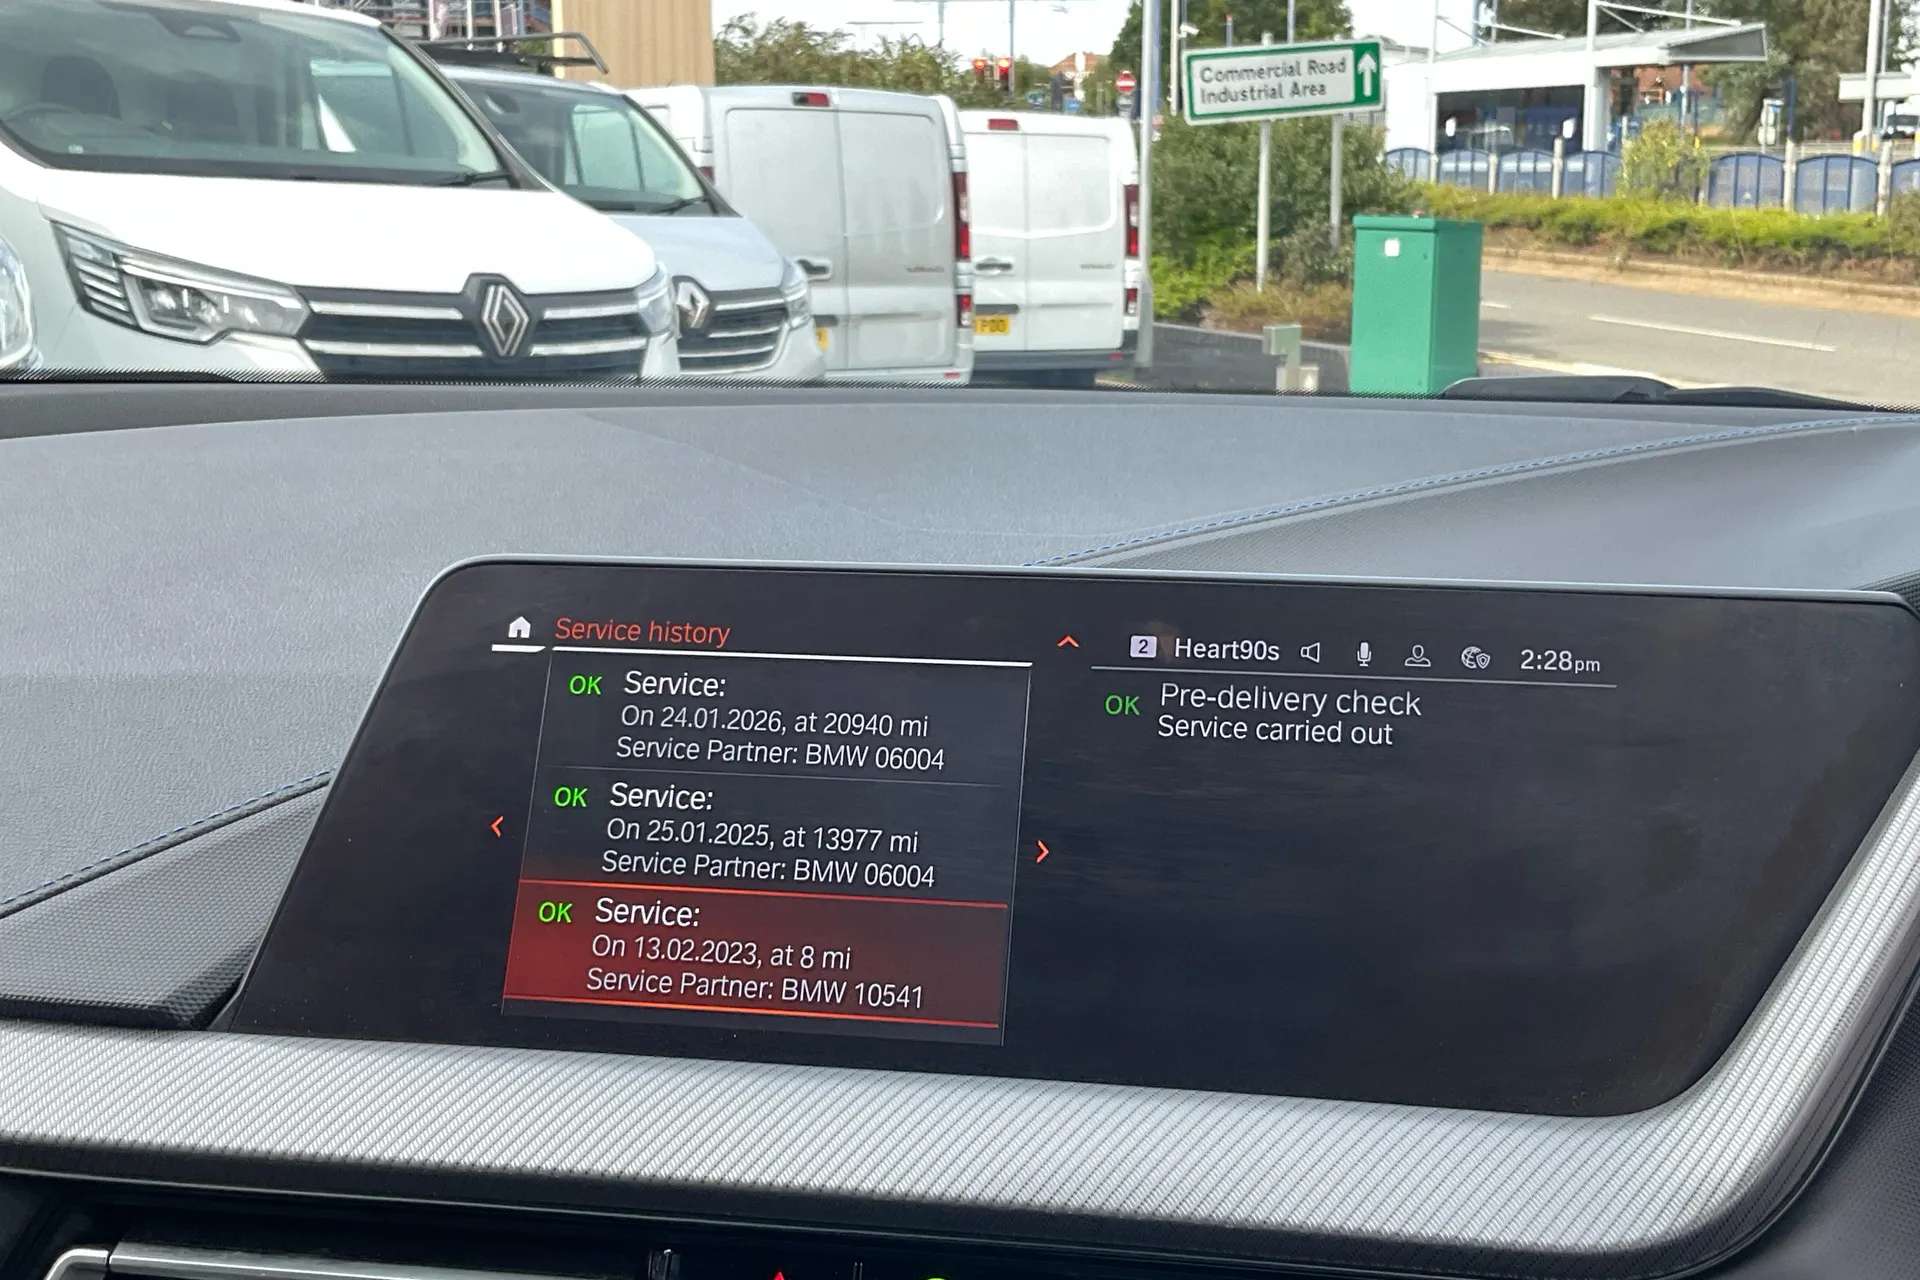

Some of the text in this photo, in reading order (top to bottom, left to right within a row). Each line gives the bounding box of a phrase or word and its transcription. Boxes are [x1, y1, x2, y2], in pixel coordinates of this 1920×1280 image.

[1200, 57, 1346, 84] Commercial Road
[1200, 80, 1327, 104] Industrial Area
[555, 617, 731, 649] Service history
[1138, 638, 1149, 655] 2
[1174, 637, 1280, 661] Heart90s
[569, 675, 603, 695] OK
[623, 670, 726, 697] Service:
[1105, 694, 1140, 716] OK
[1159, 682, 1422, 719] Pre-delivery check
[621, 704, 929, 737] On 24.01.2026, at 20940 mi
[1158, 714, 1393, 745] Service carried out
[616, 735, 945, 771] Service Partner: BMW 06004
[554, 786, 588, 808] OK
[609, 781, 713, 811] Service:
[607, 817, 919, 854] On 25.01.2025, at 13977 mi
[601, 849, 935, 888] Service Partner: BMW 06004
[538, 901, 573, 923] OK
[594, 897, 700, 927] Service:
[592, 934, 851, 970] On 13.02.2023, at 8 mi
[586, 967, 922, 1009] Service Partner: BMW 10541
